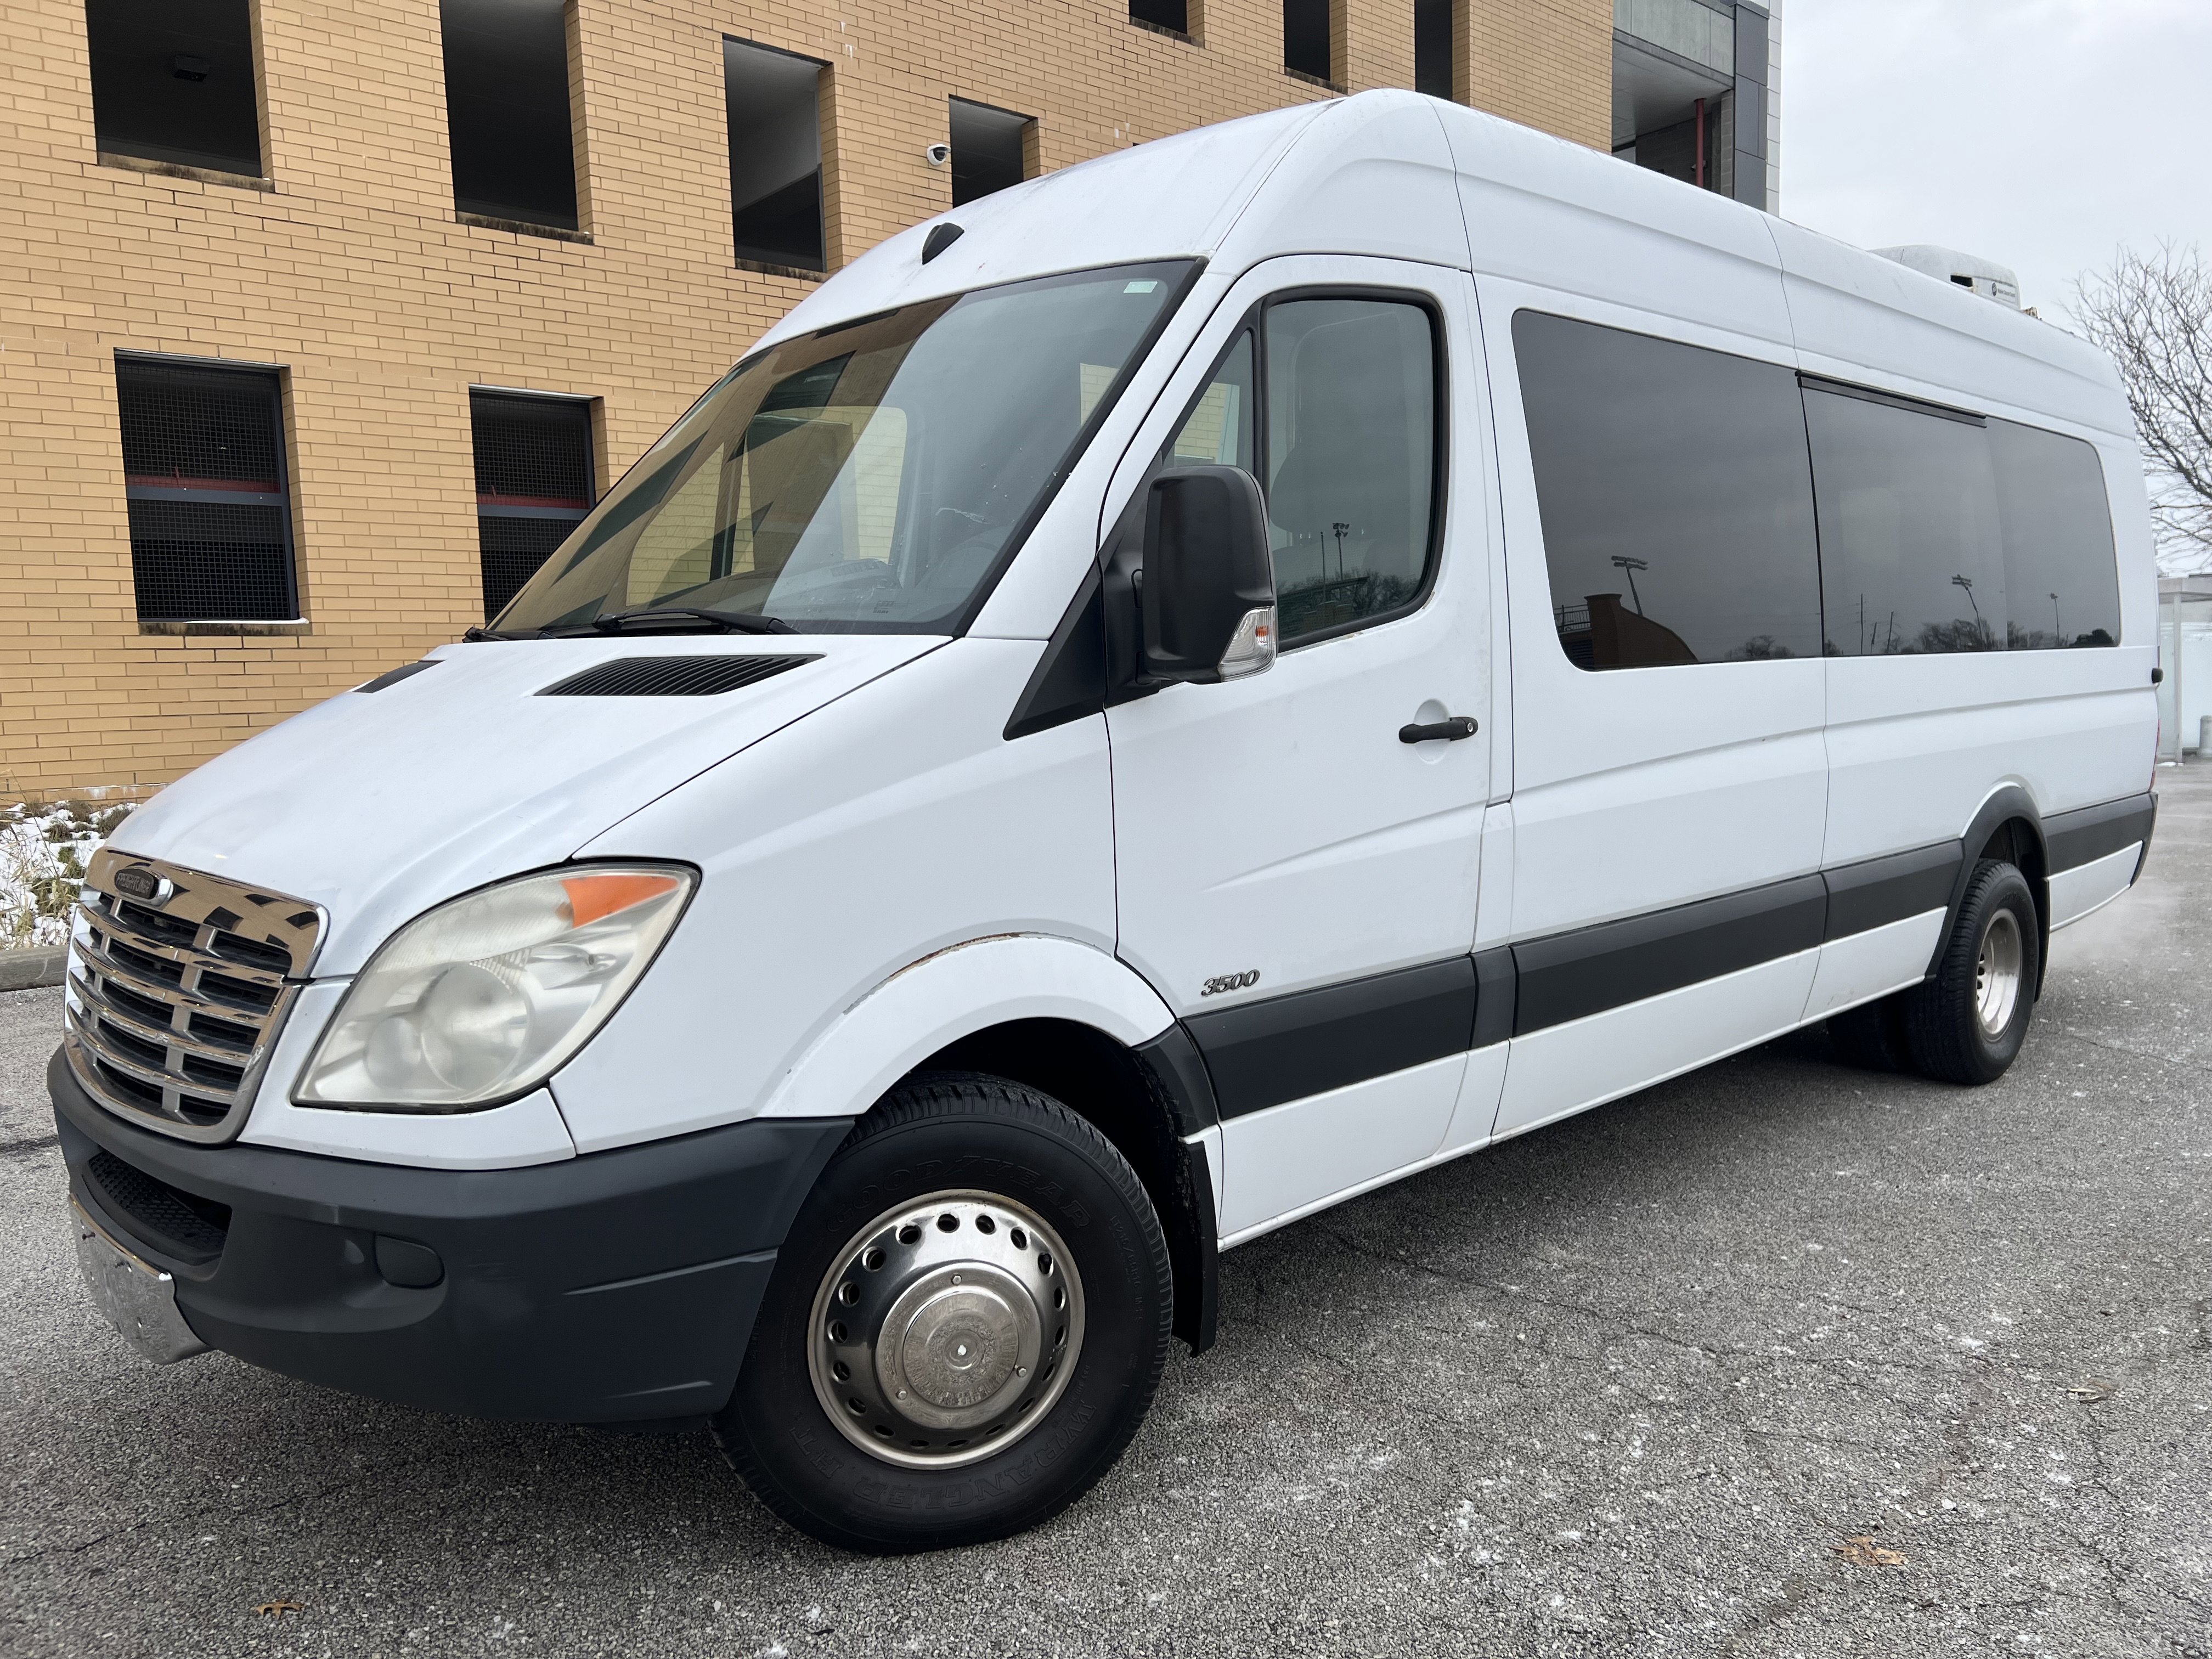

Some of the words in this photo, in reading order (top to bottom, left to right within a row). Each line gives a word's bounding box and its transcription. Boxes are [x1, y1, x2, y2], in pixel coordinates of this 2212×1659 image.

[1201, 969, 1260, 996] 3500
[826, 1155, 1091, 1233] GOODYEAR
[788, 1426, 845, 1480] HT
[852, 1402, 1097, 1509] WRANGLER
